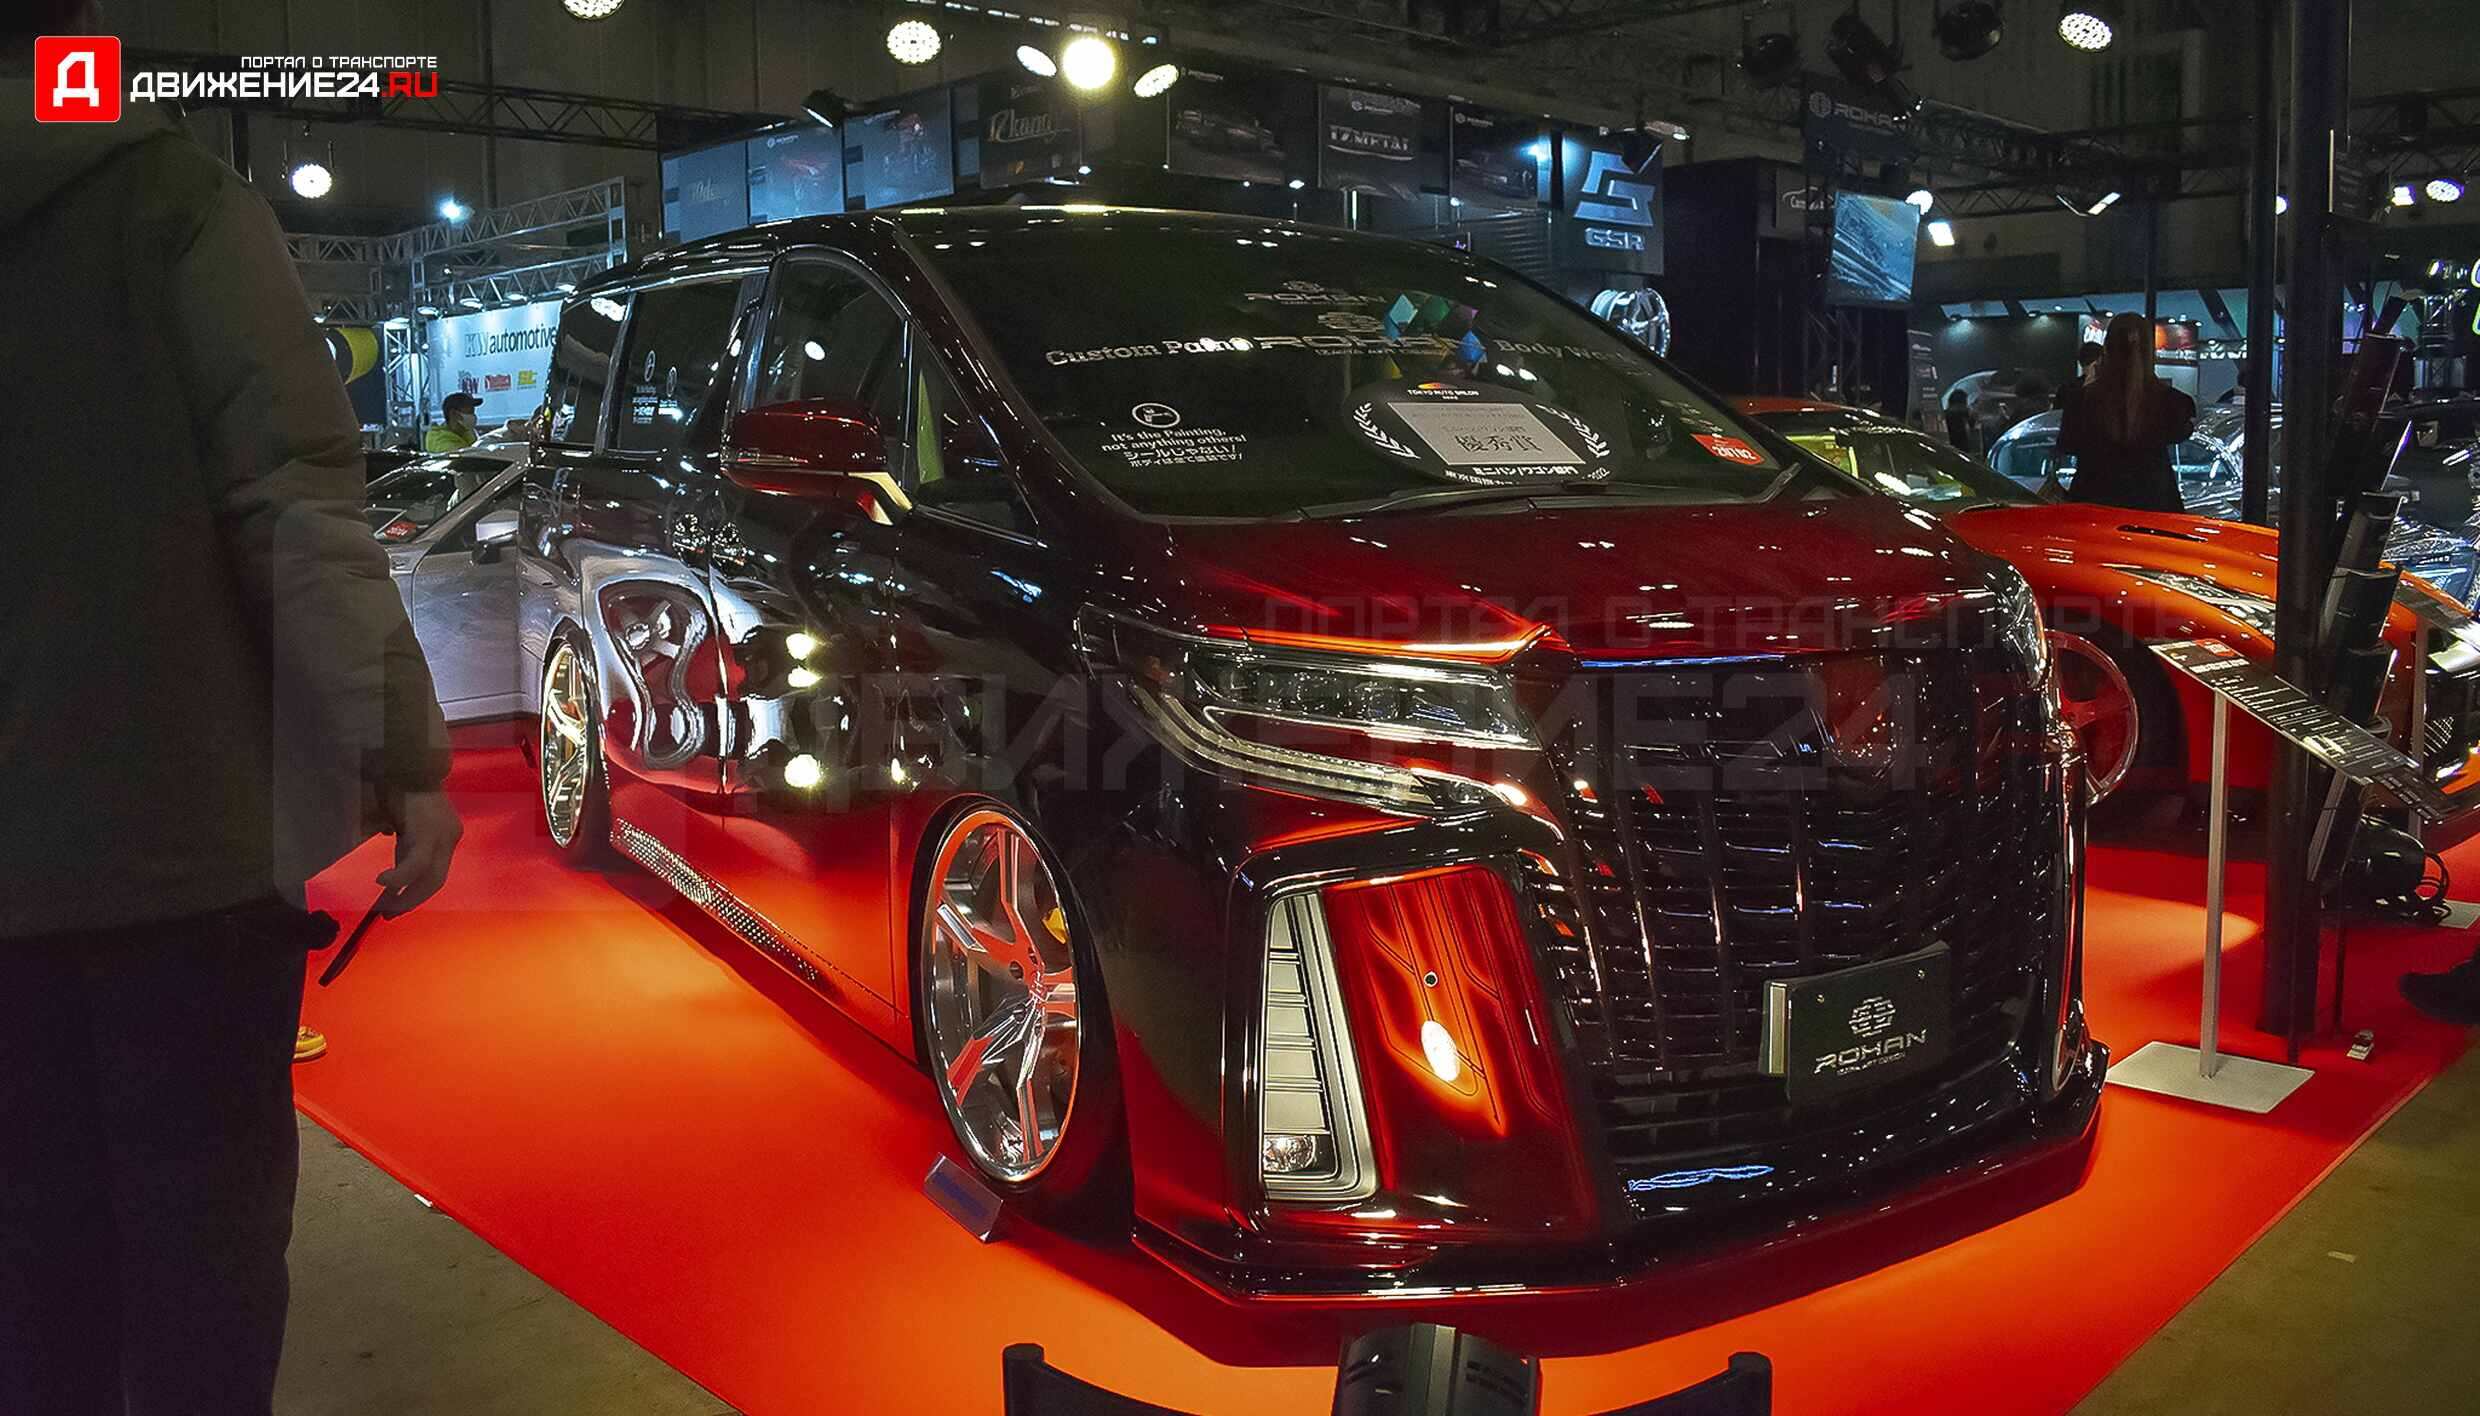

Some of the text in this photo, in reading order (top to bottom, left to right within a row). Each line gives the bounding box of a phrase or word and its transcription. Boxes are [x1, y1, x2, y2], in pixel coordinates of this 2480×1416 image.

[1833, 102, 1907, 131] ROHA
[1584, 226, 1646, 251] GSR
[1045, 344, 1159, 366] Custom
[1161, 336, 1253, 355] Pan
[1493, 339, 1564, 359] Body
[1101, 441, 1129, 452] not
[1131, 437, 1196, 450] anything
[1111, 432, 1135, 443] It's
[1136, 430, 1162, 440] the
[1813, 1028, 1928, 1075] ROHAN
